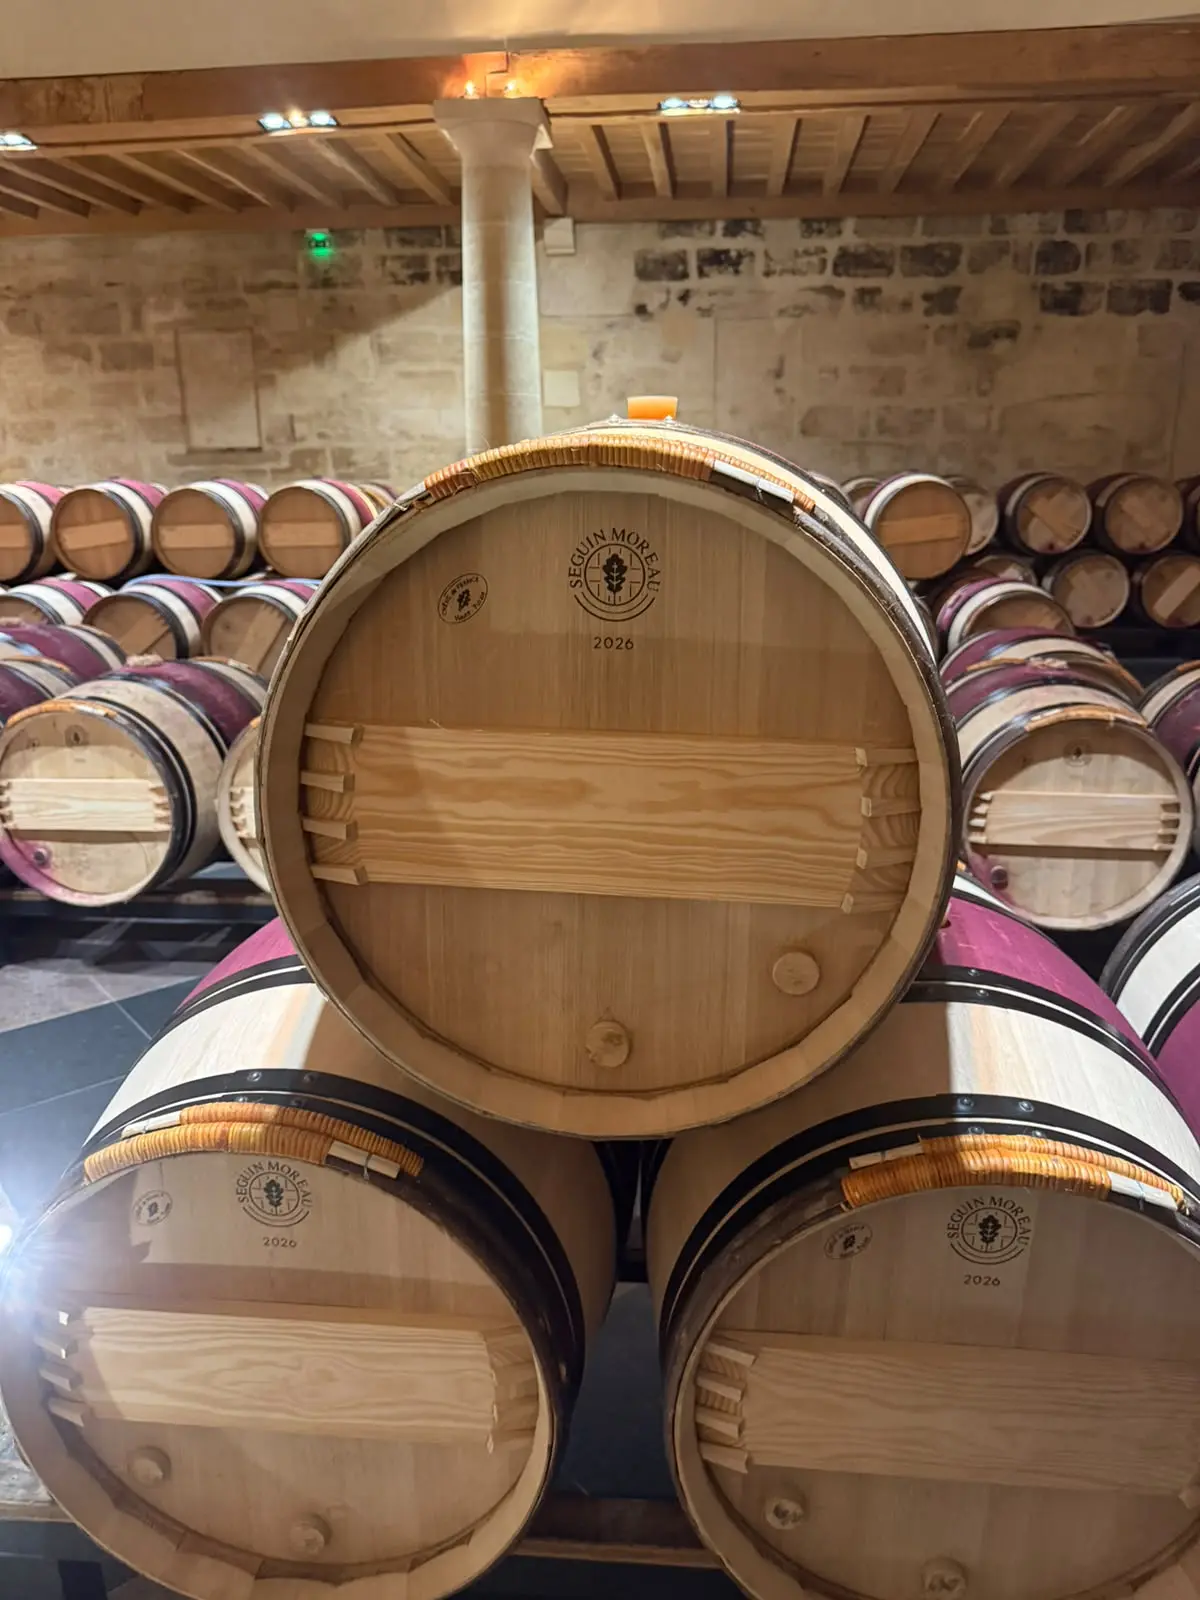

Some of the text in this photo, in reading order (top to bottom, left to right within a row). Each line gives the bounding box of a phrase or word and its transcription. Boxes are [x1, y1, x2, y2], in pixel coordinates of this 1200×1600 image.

[568, 527, 661, 592] SEGUIN MOREAU
[594, 637, 634, 650] 2026
[236, 1161, 312, 1208] SEGUIN MOREAU
[947, 1195, 1031, 1246] SEGUIN MOREAU
[964, 1274, 1000, 1286] 2026
